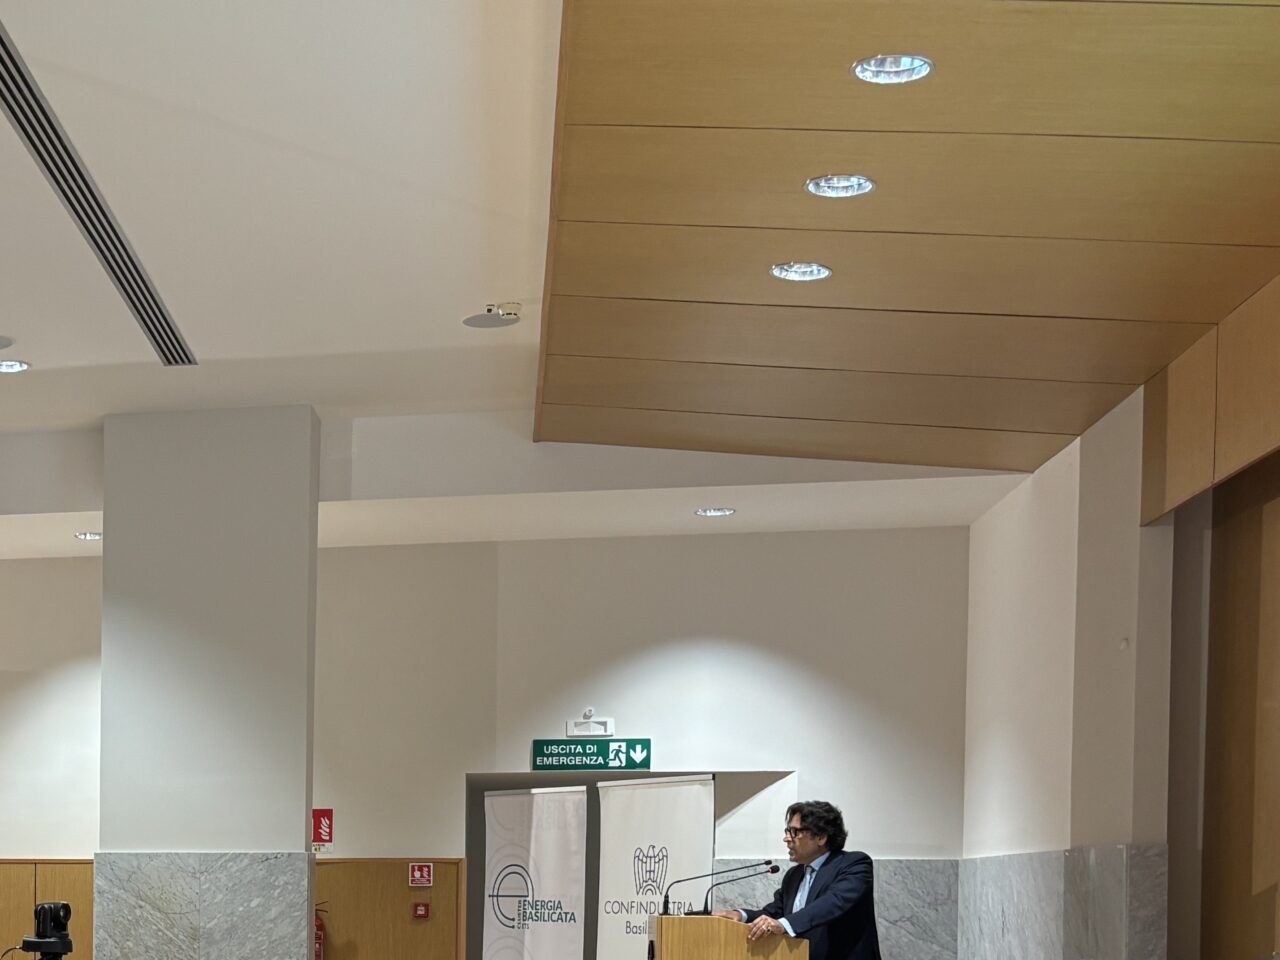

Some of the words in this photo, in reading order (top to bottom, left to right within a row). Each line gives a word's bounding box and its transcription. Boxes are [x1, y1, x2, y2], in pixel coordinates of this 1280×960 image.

[543, 744, 583, 754] USCITA
[586, 744, 597, 753] DI
[536, 756, 604, 765] EMERGENZA
[522, 900, 563, 911] ENERGIA
[522, 911, 577, 923] BASILICATA
[625, 920, 648, 935] Basil
